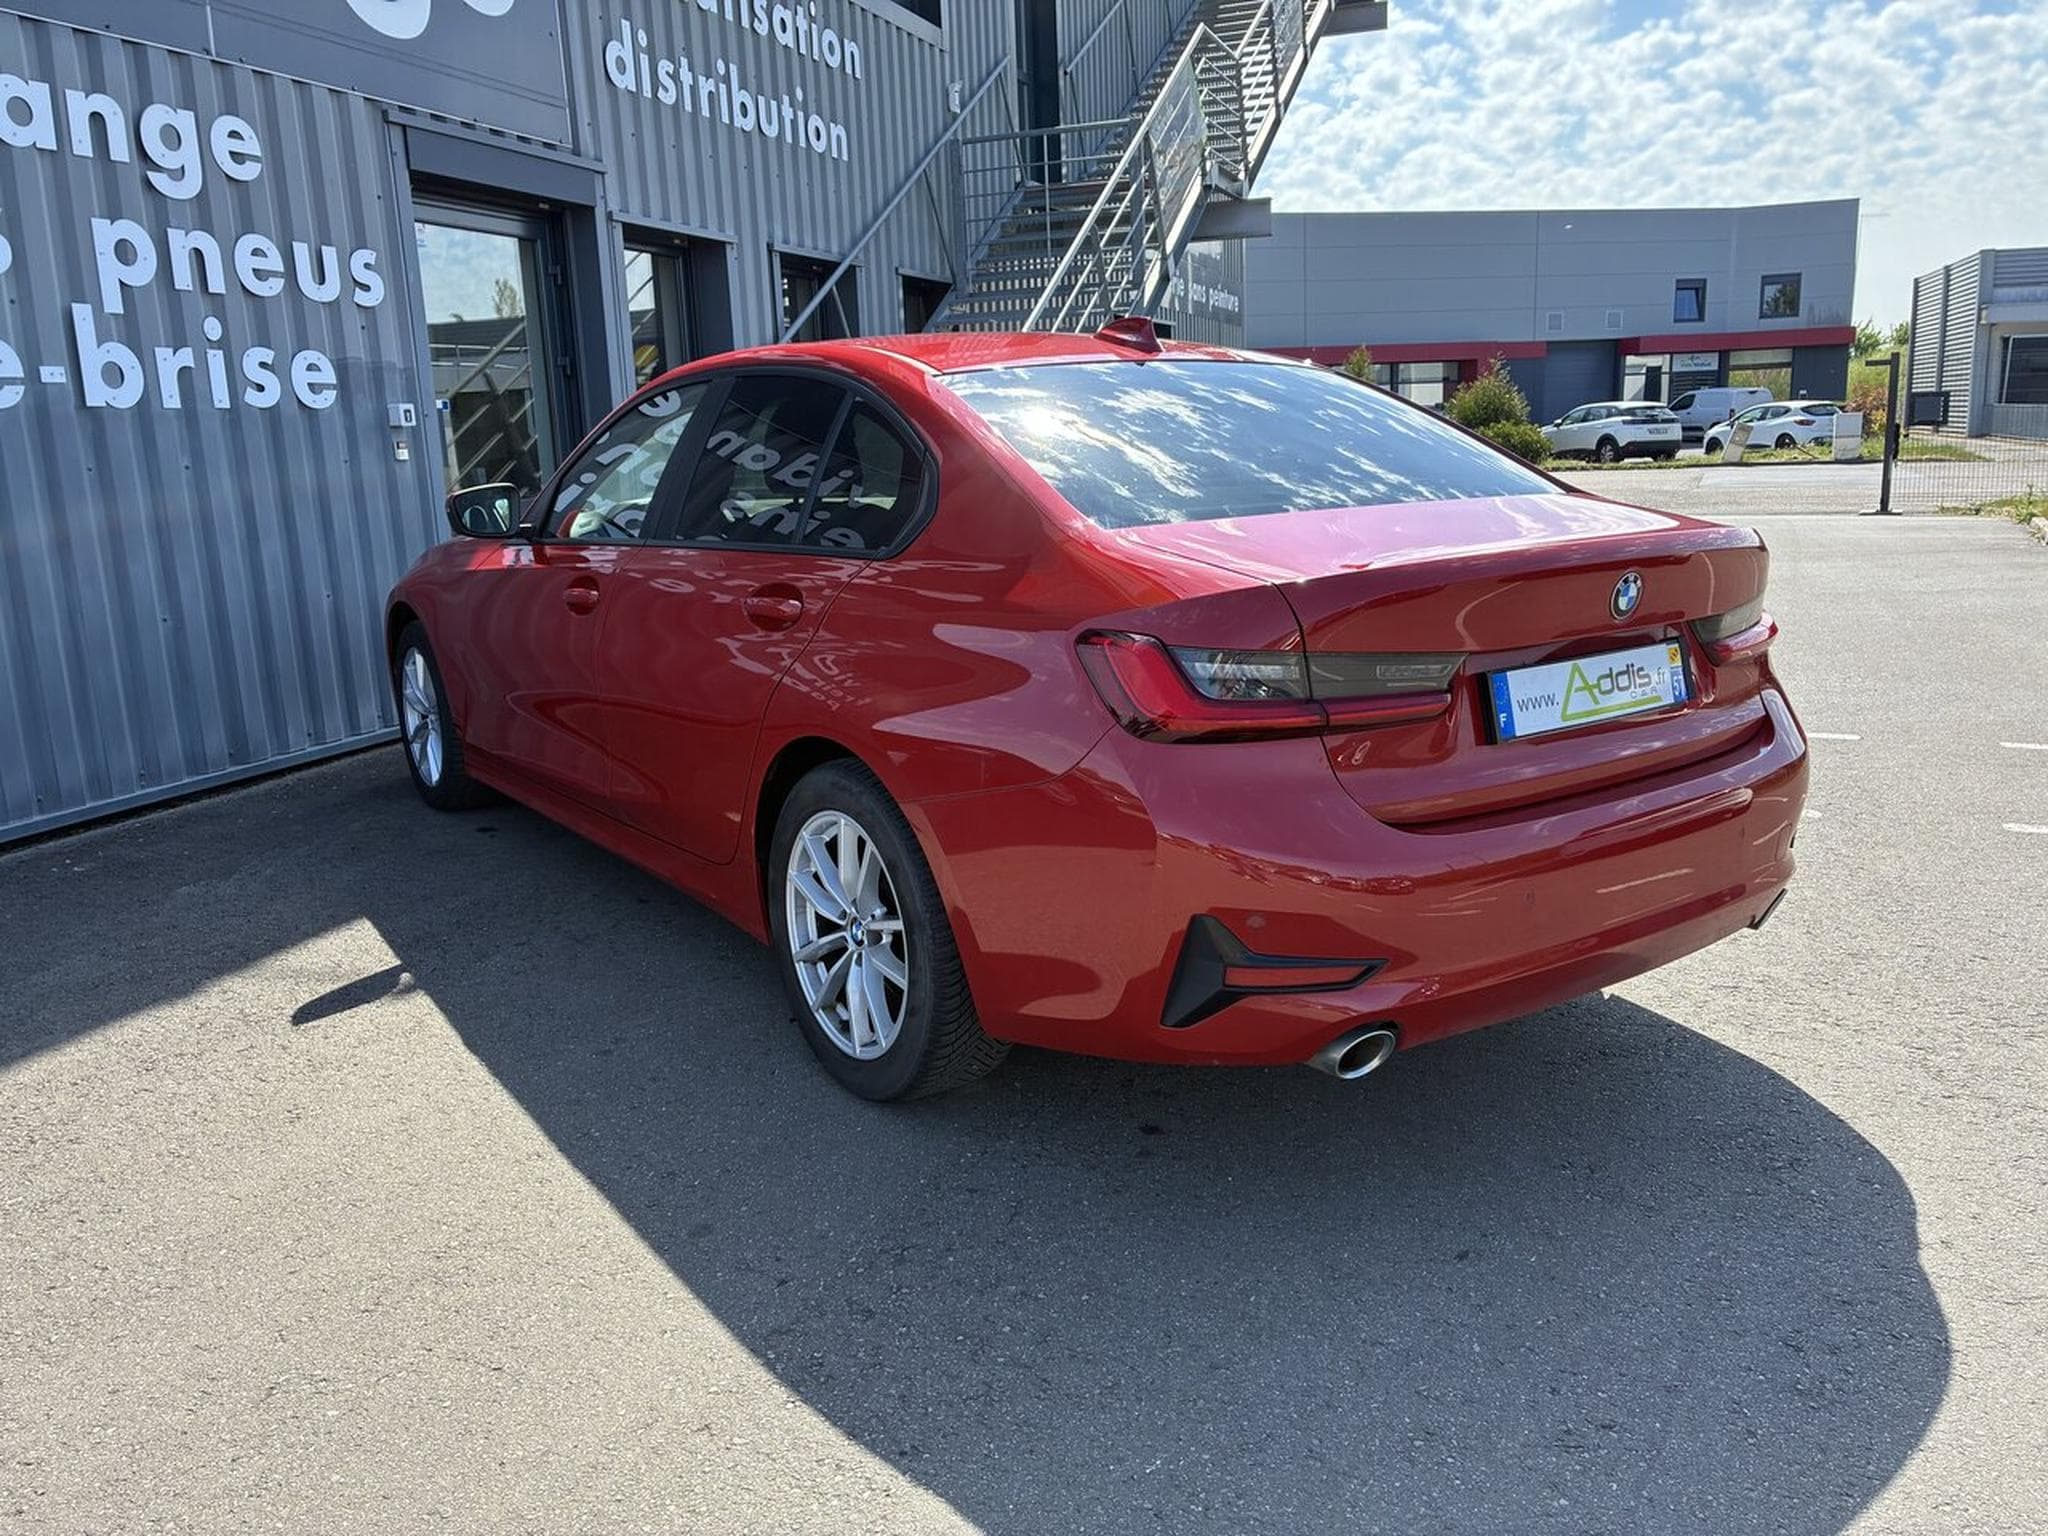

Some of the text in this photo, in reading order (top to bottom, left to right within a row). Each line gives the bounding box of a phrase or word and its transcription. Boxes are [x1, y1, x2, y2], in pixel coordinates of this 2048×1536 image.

[604, 19, 849, 162] distribution
[91, 217, 386, 315] pneus
[1499, 713, 1508, 728] F
